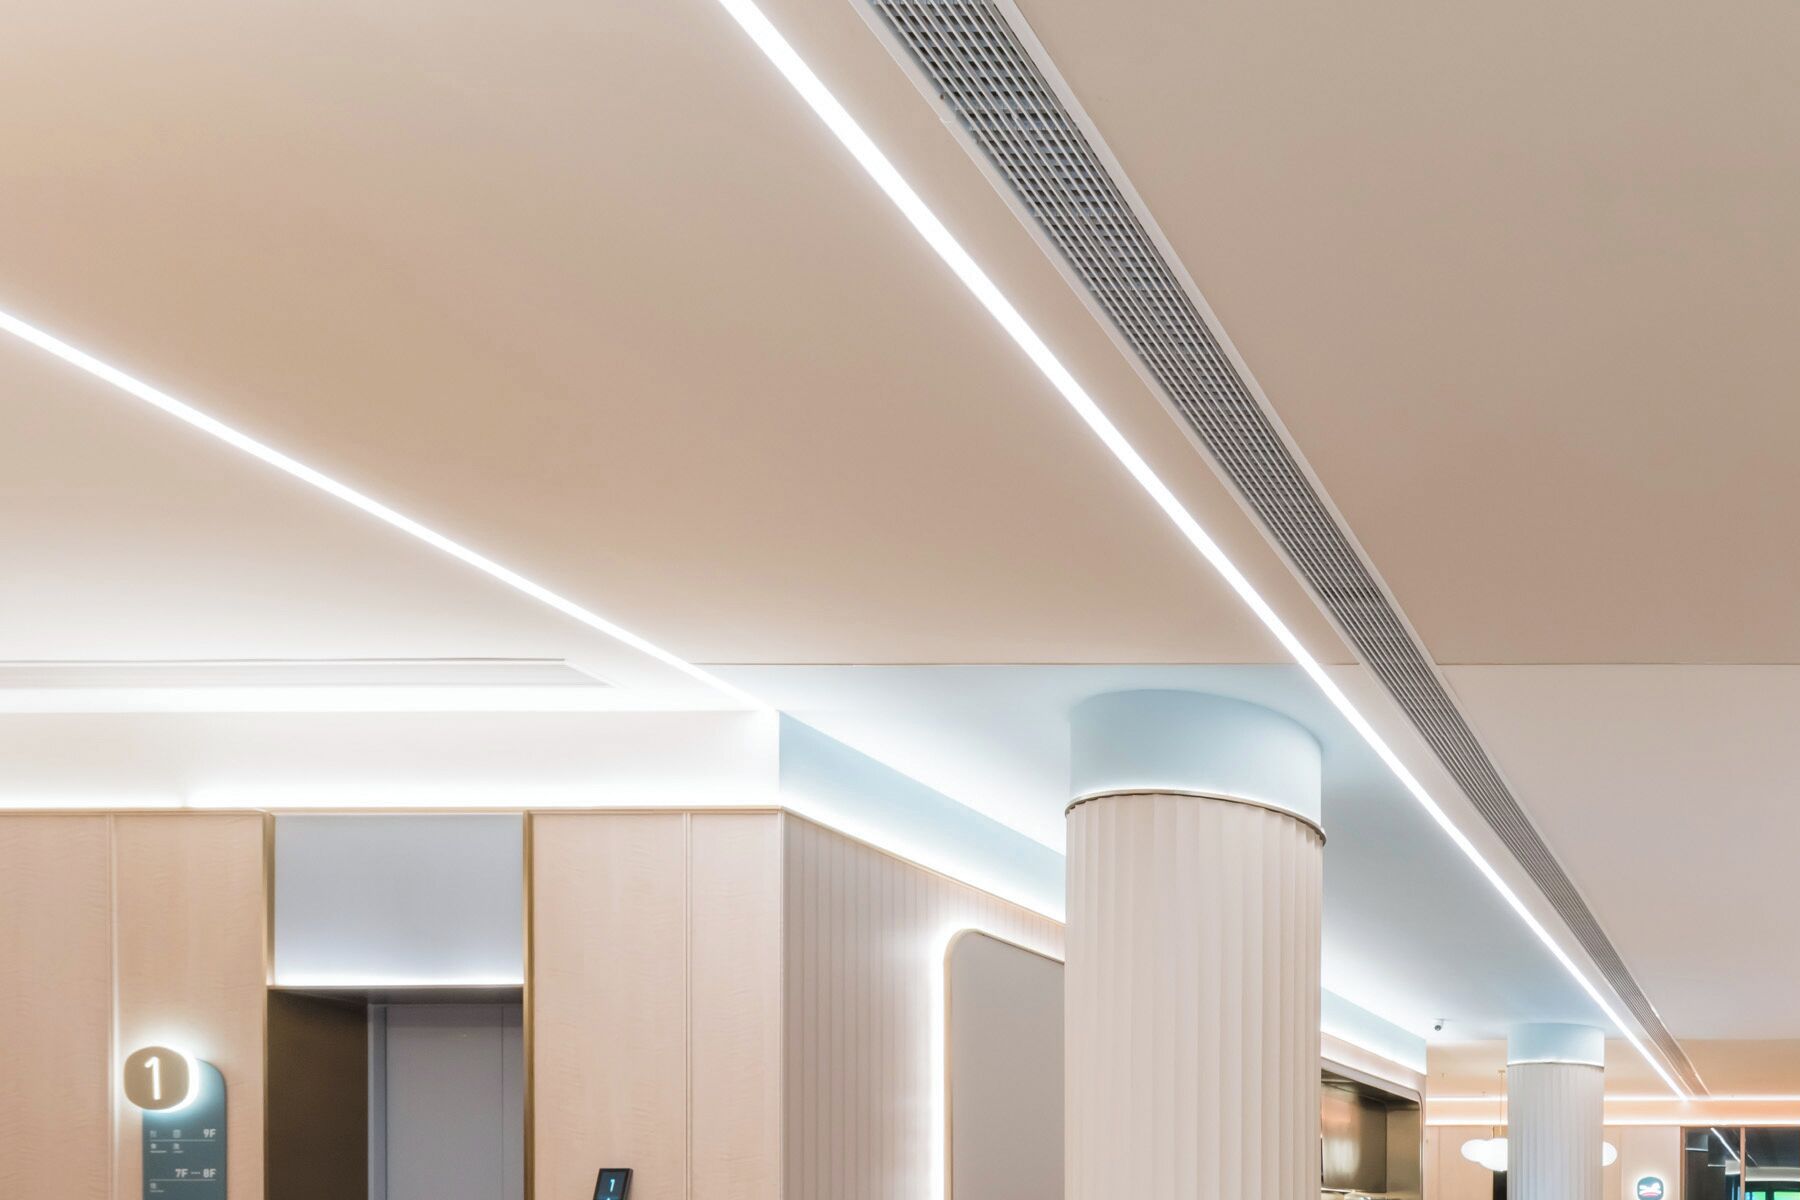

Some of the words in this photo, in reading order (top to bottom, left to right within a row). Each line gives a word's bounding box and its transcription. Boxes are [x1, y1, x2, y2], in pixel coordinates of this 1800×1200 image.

[144, 1056, 160, 1101] 1
[203, 1128, 217, 1138] 9F
[175, 1168, 189, 1178] 7F
[203, 1168, 217, 1178] 8F
[610, 1178, 616, 1192] 1
